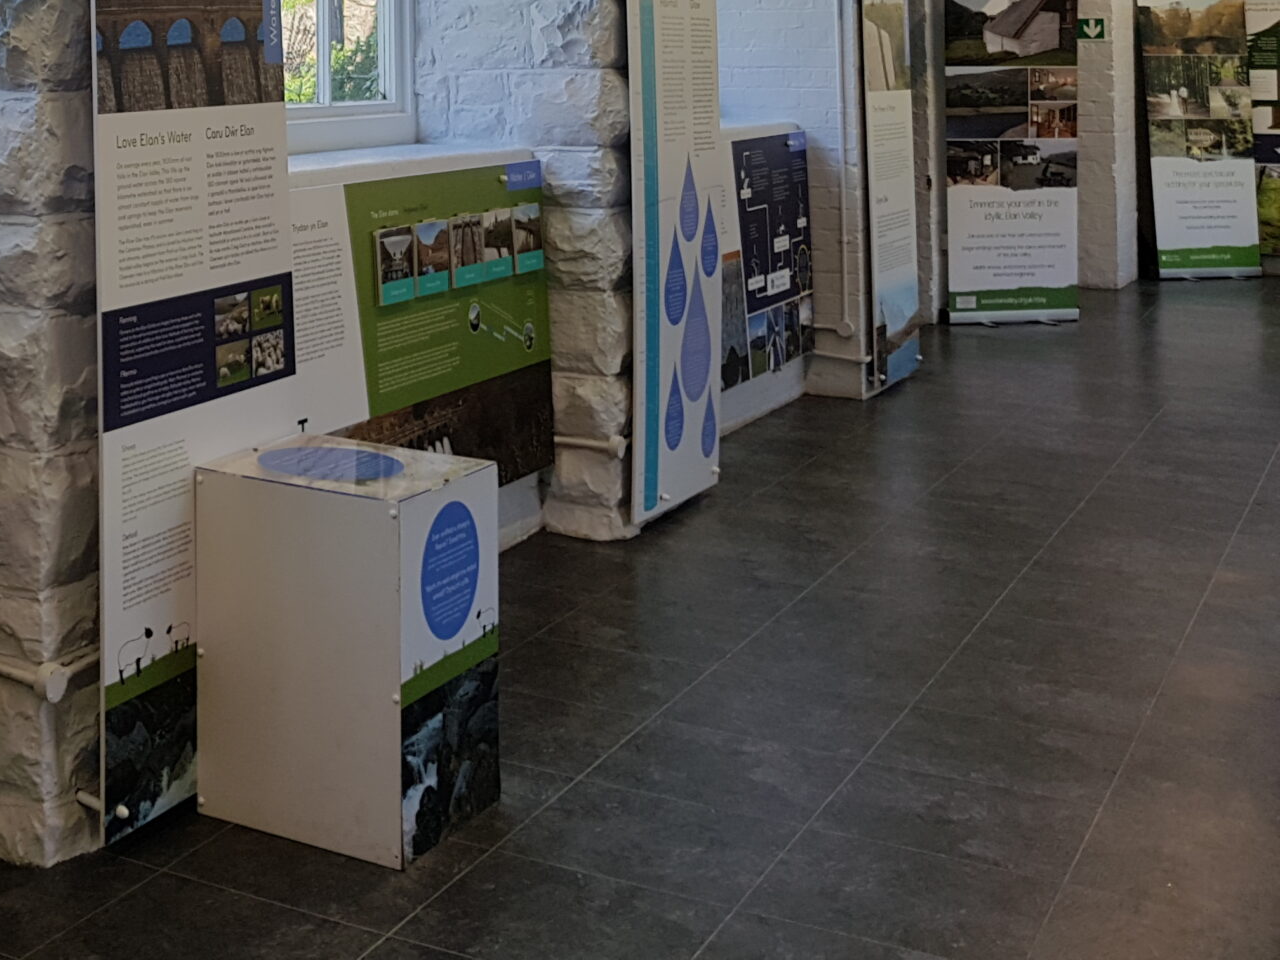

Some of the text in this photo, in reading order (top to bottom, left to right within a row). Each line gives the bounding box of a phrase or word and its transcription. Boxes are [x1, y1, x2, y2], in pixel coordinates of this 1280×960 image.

[116, 130, 192, 150] Love Elan's Water
[205, 127, 223, 140] Caru
[240, 124, 256, 137] Elan
